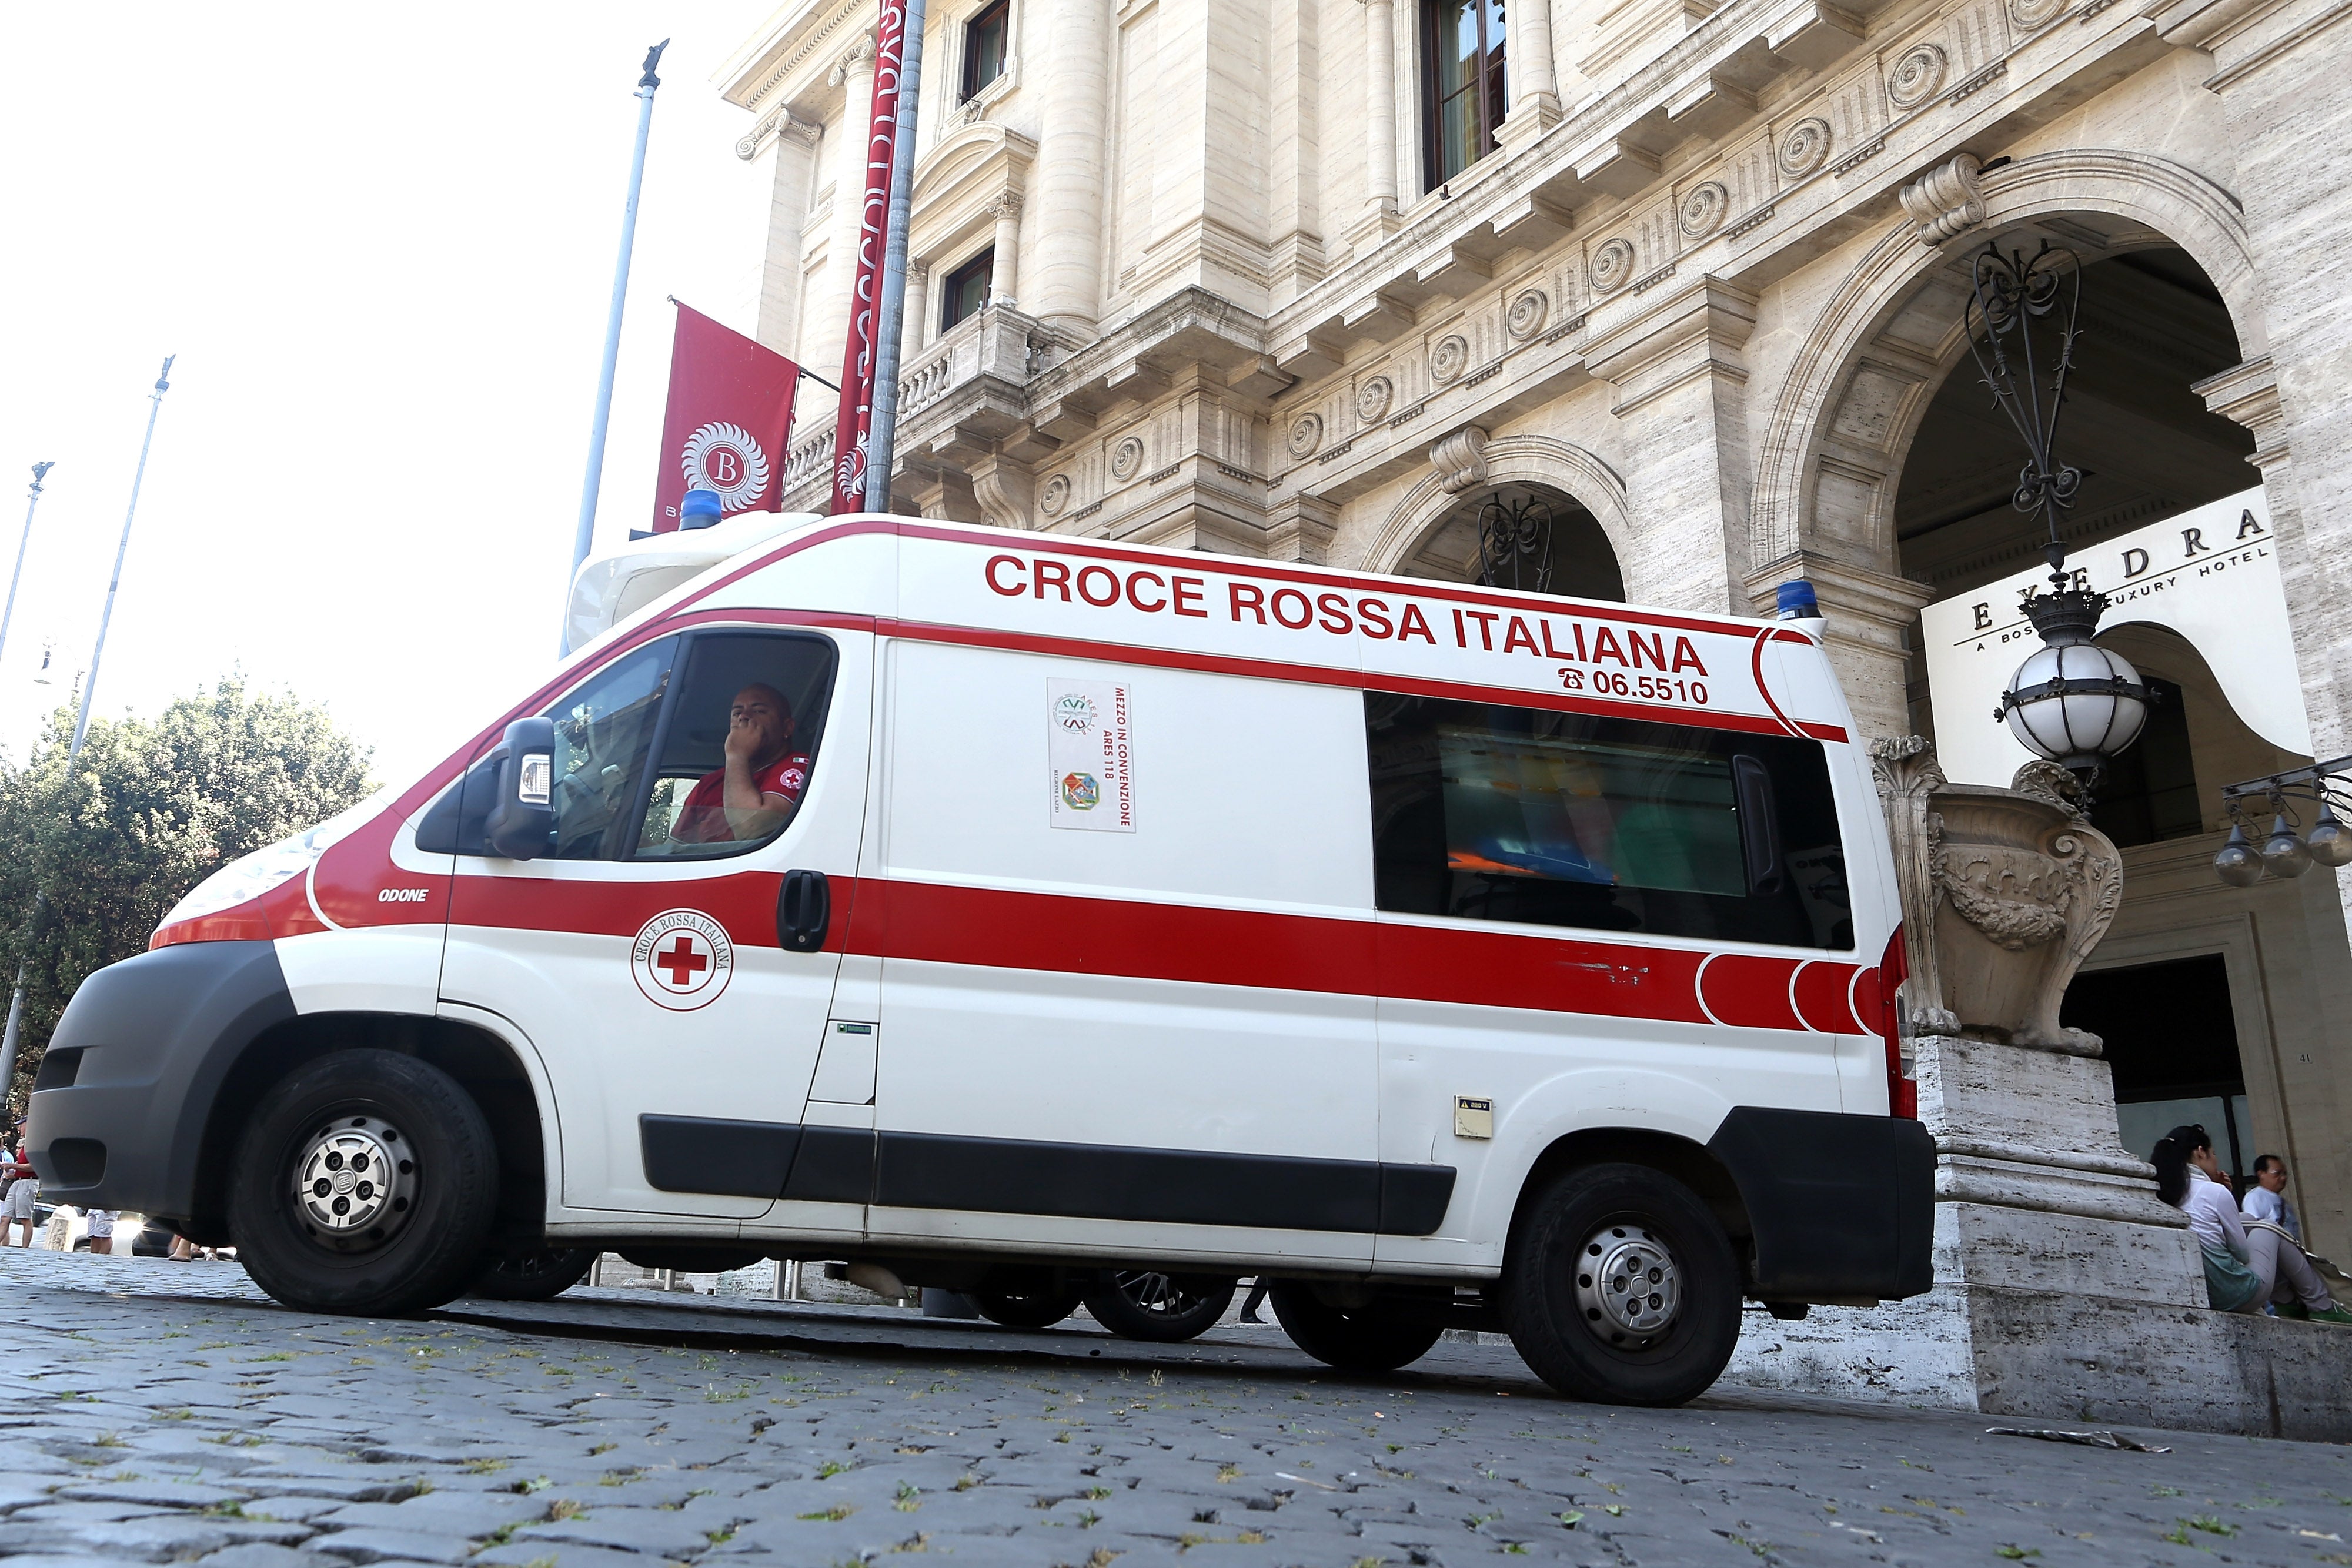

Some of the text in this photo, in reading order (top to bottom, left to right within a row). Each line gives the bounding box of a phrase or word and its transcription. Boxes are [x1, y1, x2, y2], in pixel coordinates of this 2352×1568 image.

[714, 451, 736, 482] B
[985, 555, 1708, 677] CROCE ROSSA ITALIANA
[1977, 643, 1986, 651] A
[2107, 577, 2176, 610] UXURY
[2200, 549, 2269, 577] HOTEL
[1593, 671, 1708, 704] 06.5510
[1080, 694, 1098, 736] ARES 118
[1103, 730, 1114, 780] ARES 118
[1115, 687, 1130, 826] MEZZO IN CONVENZIONE
[378, 888, 429, 902] ODONE
[635, 914, 730, 969] CROCE ROSSA ITALIANA
[2299, 1053, 2310, 1062] 41
